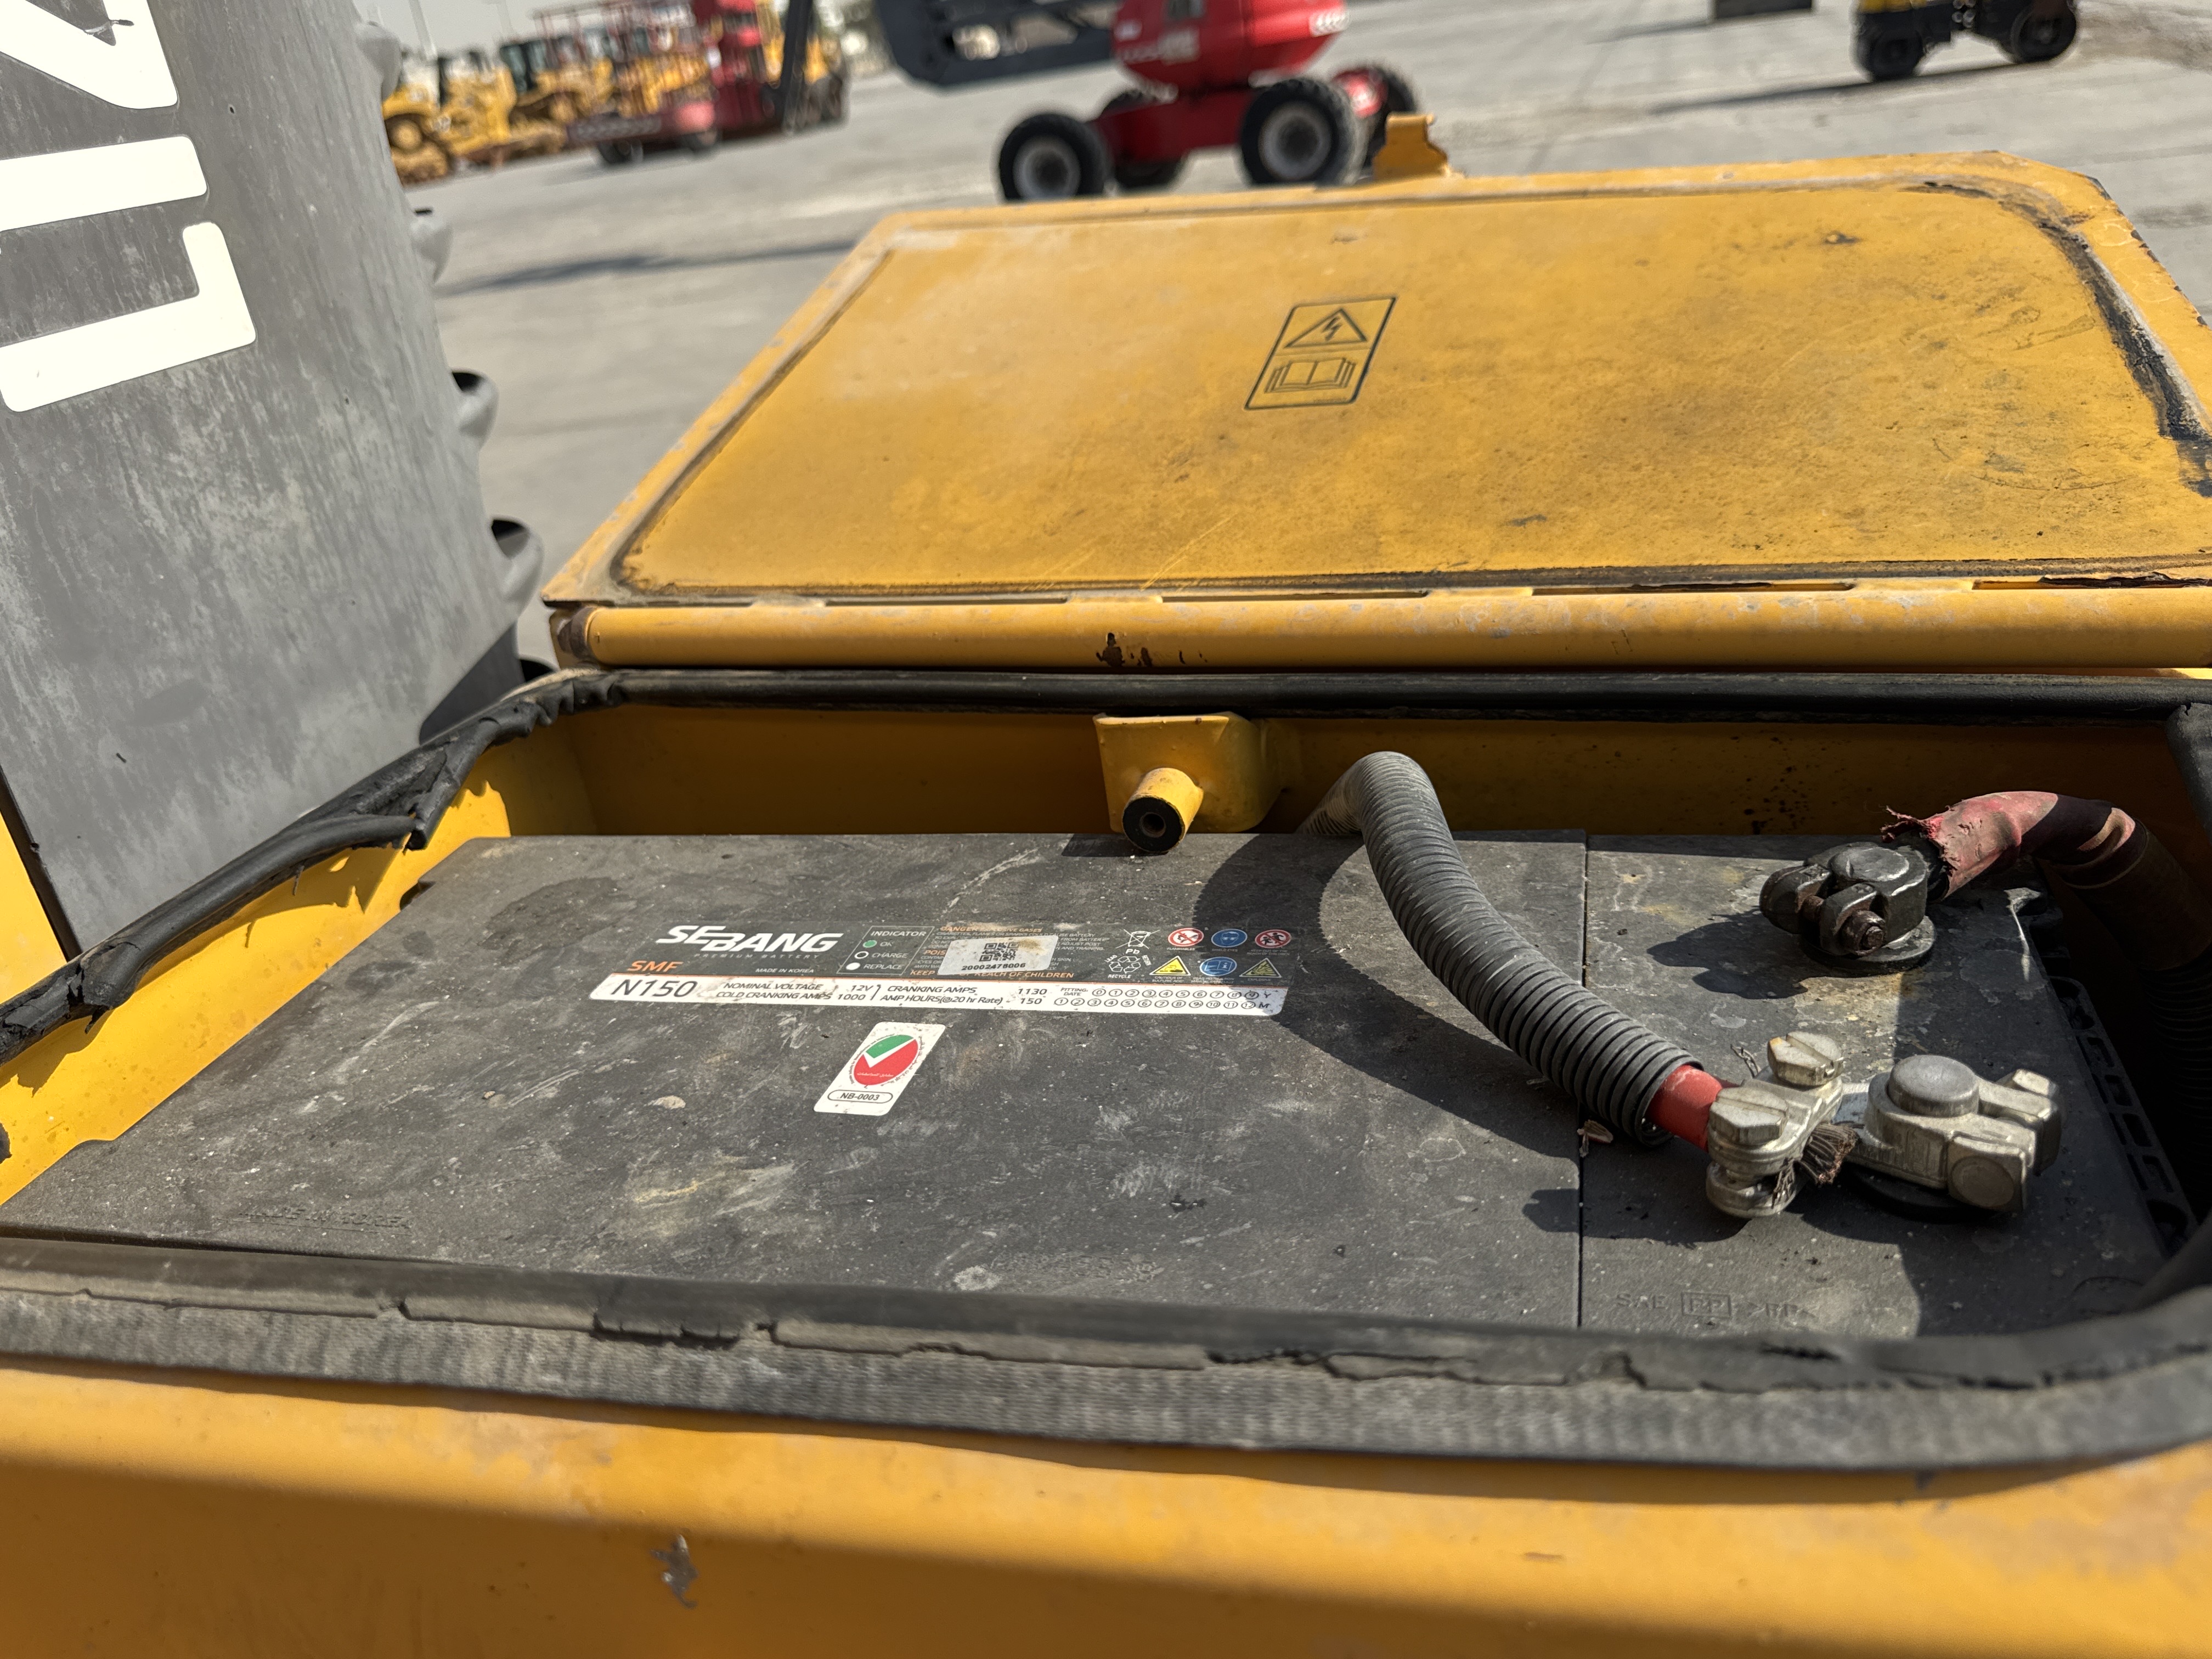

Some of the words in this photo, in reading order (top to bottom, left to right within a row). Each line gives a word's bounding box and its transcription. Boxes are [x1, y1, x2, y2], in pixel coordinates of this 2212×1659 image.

[656, 925, 844, 952] SEBANG
[627, 960, 684, 972] SMF
[611, 979, 698, 997] N150
[840, 1092, 880, 1101] NB-0003
